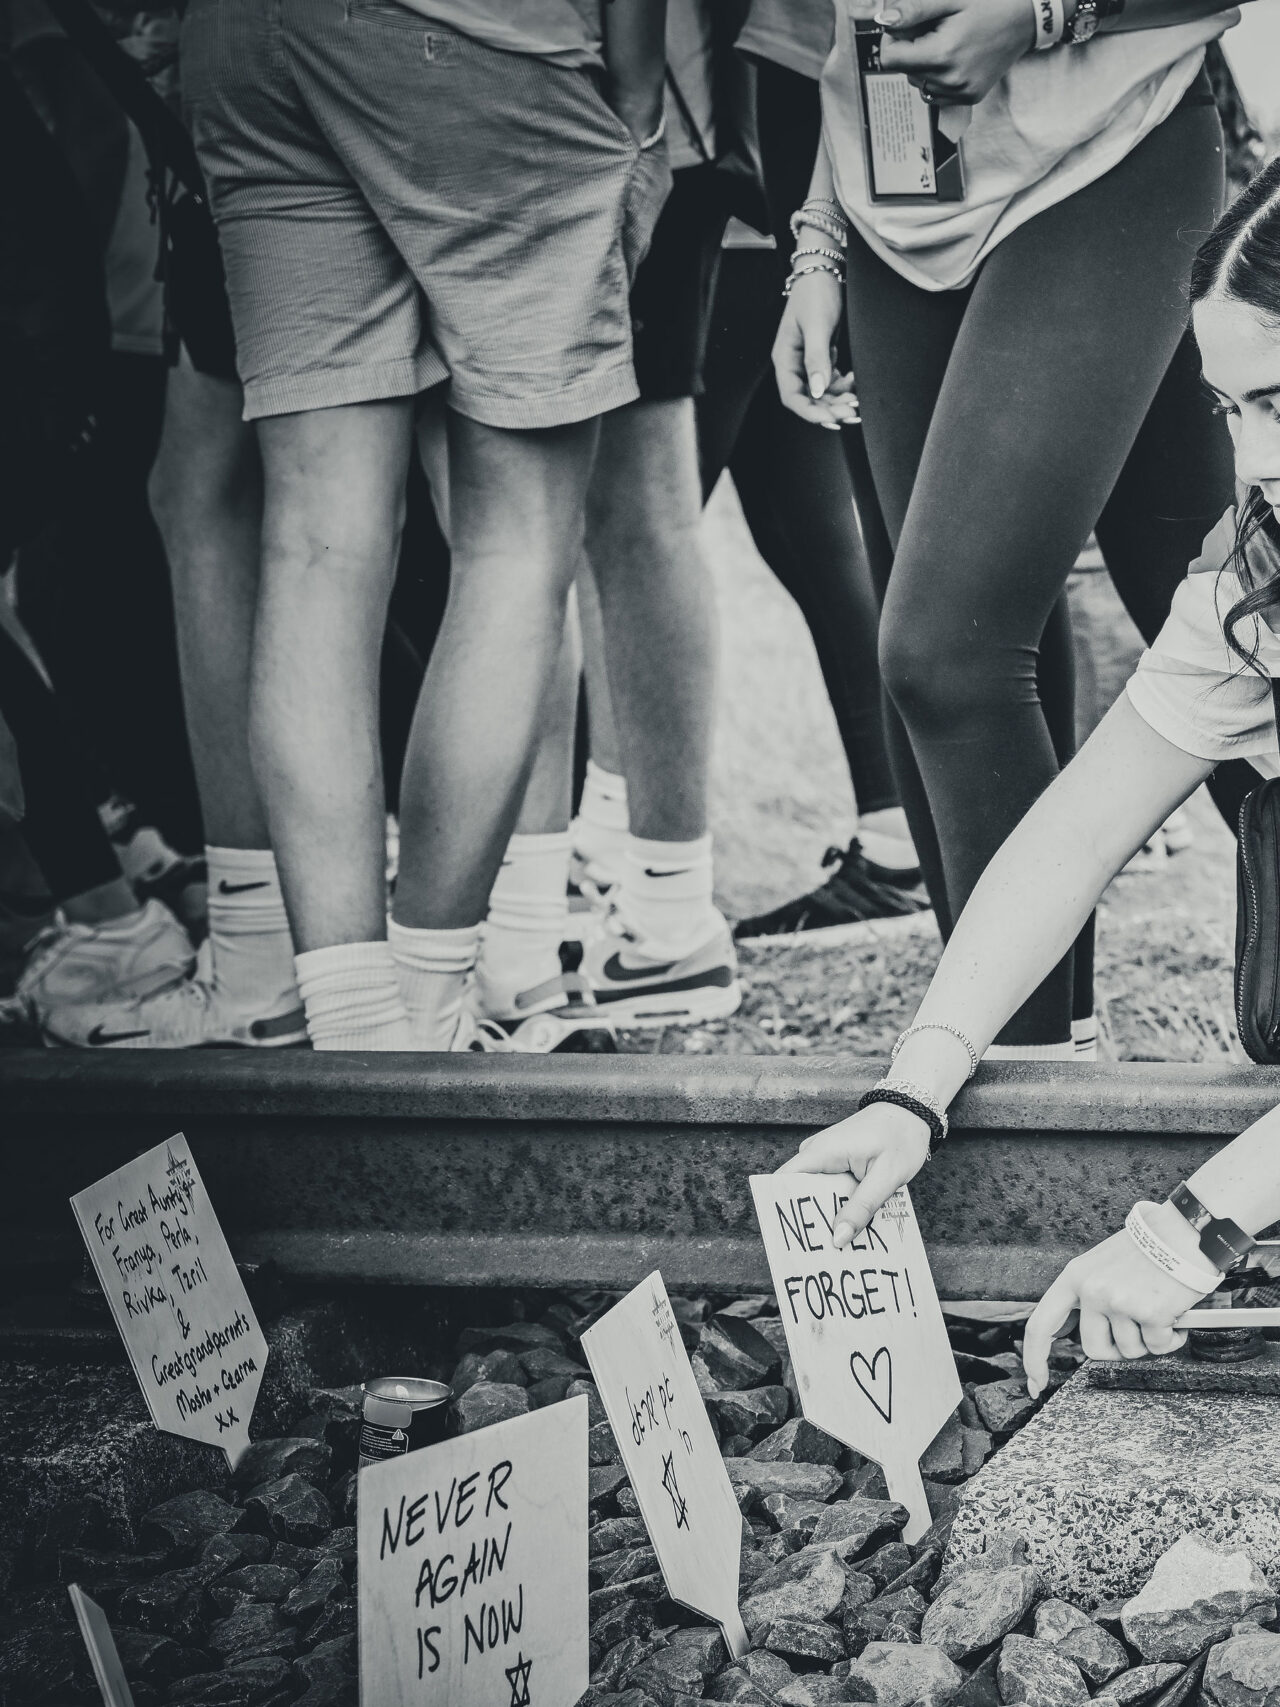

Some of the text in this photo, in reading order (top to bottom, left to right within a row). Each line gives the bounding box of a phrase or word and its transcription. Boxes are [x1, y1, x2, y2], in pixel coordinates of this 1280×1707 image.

[1041, 0, 1054, 34] ישרא
[95, 1212, 116, 1246] For
[117, 1201, 147, 1231] Great
[112, 1244, 163, 1276] Franya,
[784, 1268, 918, 1324] FORGET!
[176, 1308, 191, 1340] &
[175, 1388, 213, 1421] Moshe
[380, 1460, 513, 1561] NEVER
[415, 1521, 513, 1609] AGAIN
[418, 1583, 524, 1680] IS NOW
